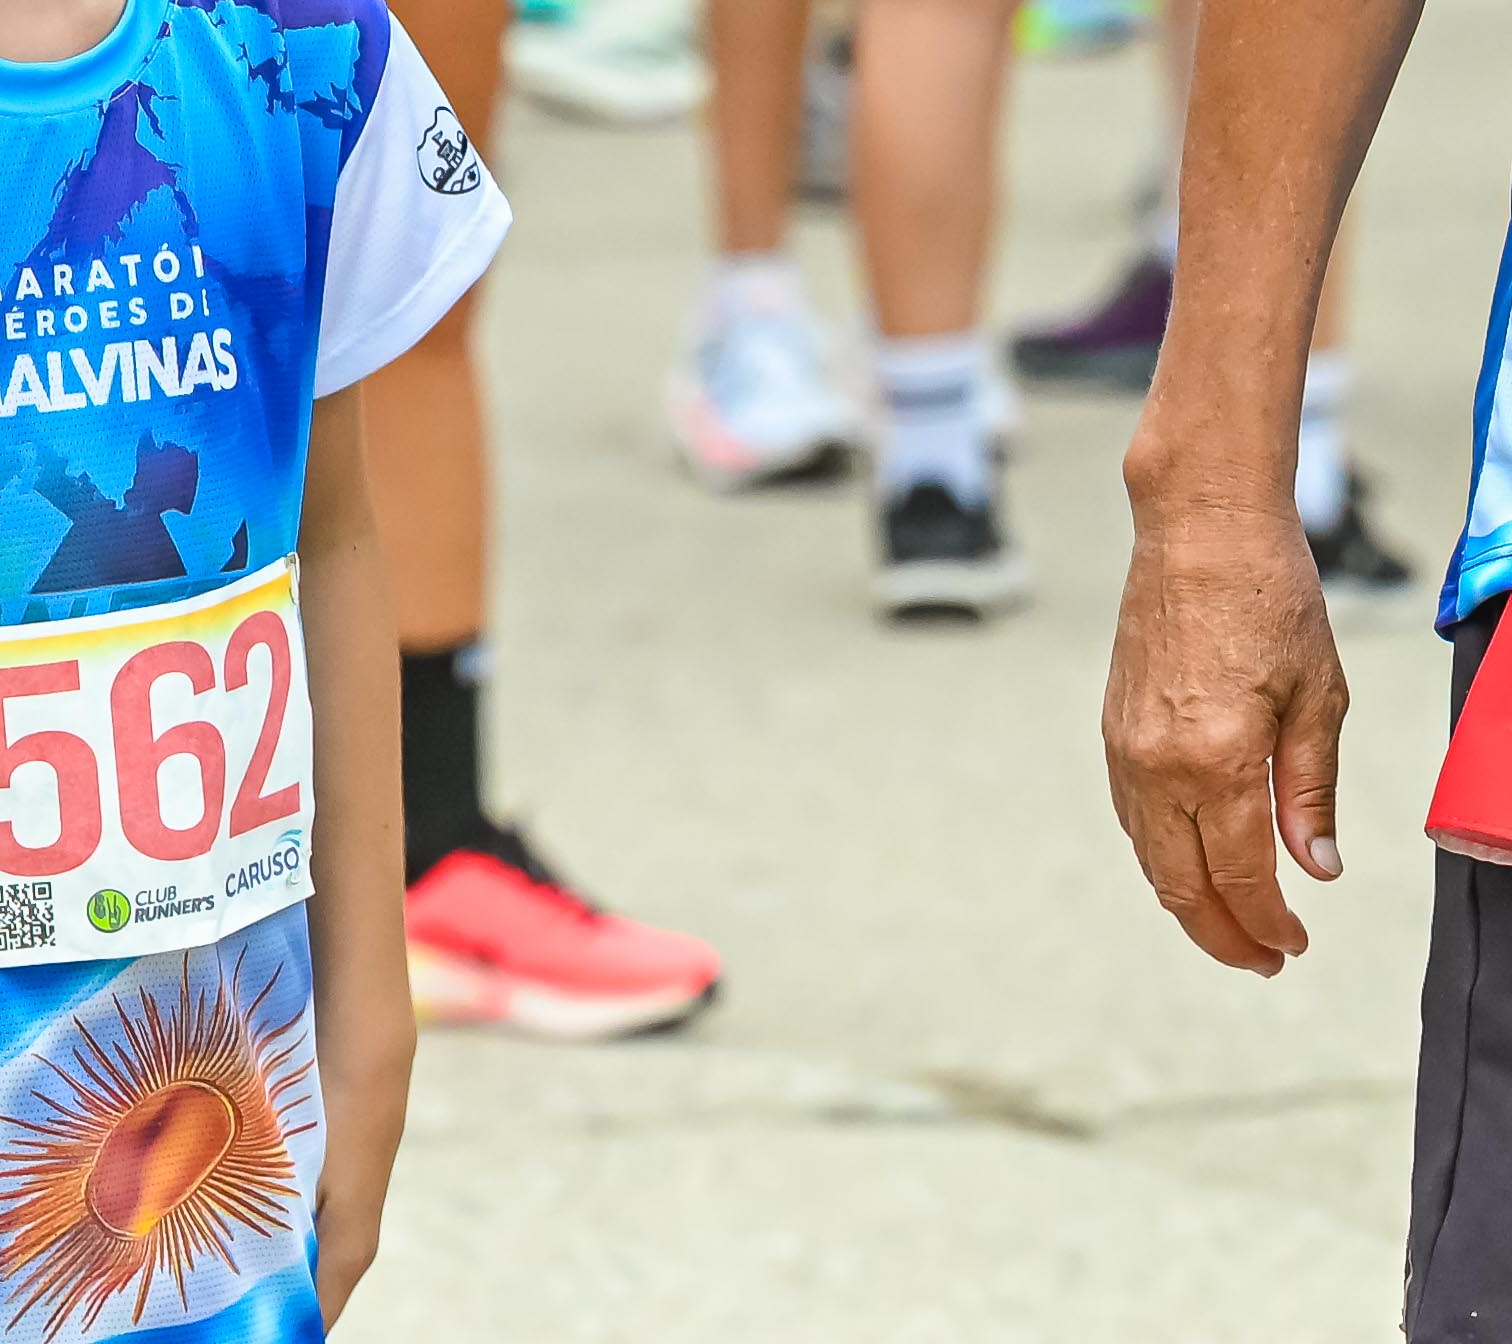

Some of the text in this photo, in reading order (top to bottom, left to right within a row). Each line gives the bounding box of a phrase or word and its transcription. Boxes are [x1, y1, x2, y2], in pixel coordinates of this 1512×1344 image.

[225, 846, 300, 898] CARUSO
[134, 885, 177, 907] CLUB
[134, 895, 215, 924] RUNNER'S
